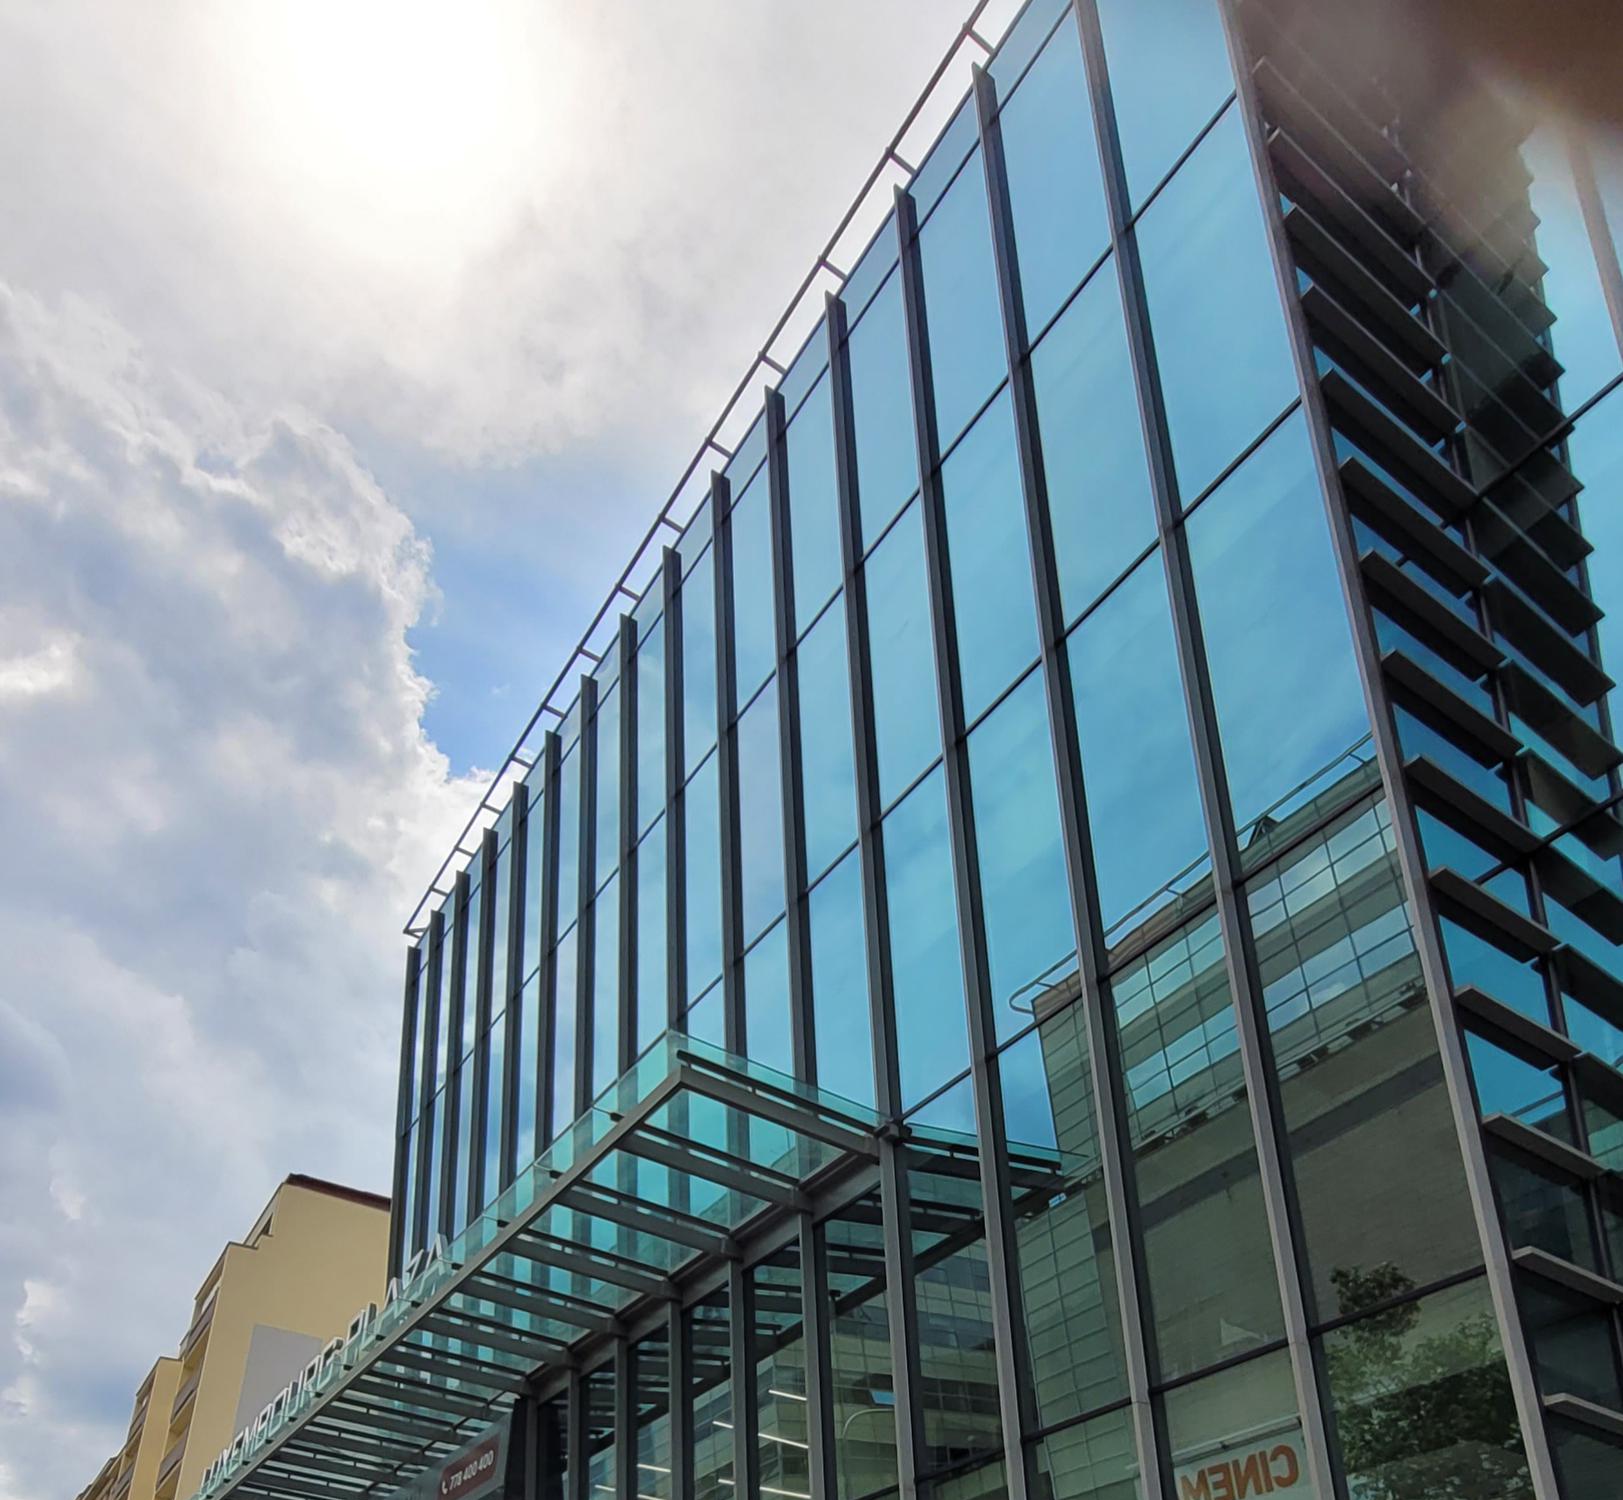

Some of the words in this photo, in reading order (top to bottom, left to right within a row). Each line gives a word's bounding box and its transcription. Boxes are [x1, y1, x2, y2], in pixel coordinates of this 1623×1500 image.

[201, 1337, 345, 1494] LUXEMBOURG
[345, 1232, 449, 1366] PLAZA
[450, 1470, 463, 1490] 778
[463, 1460, 478, 1480] 400
[478, 1449, 494, 1470] 400
